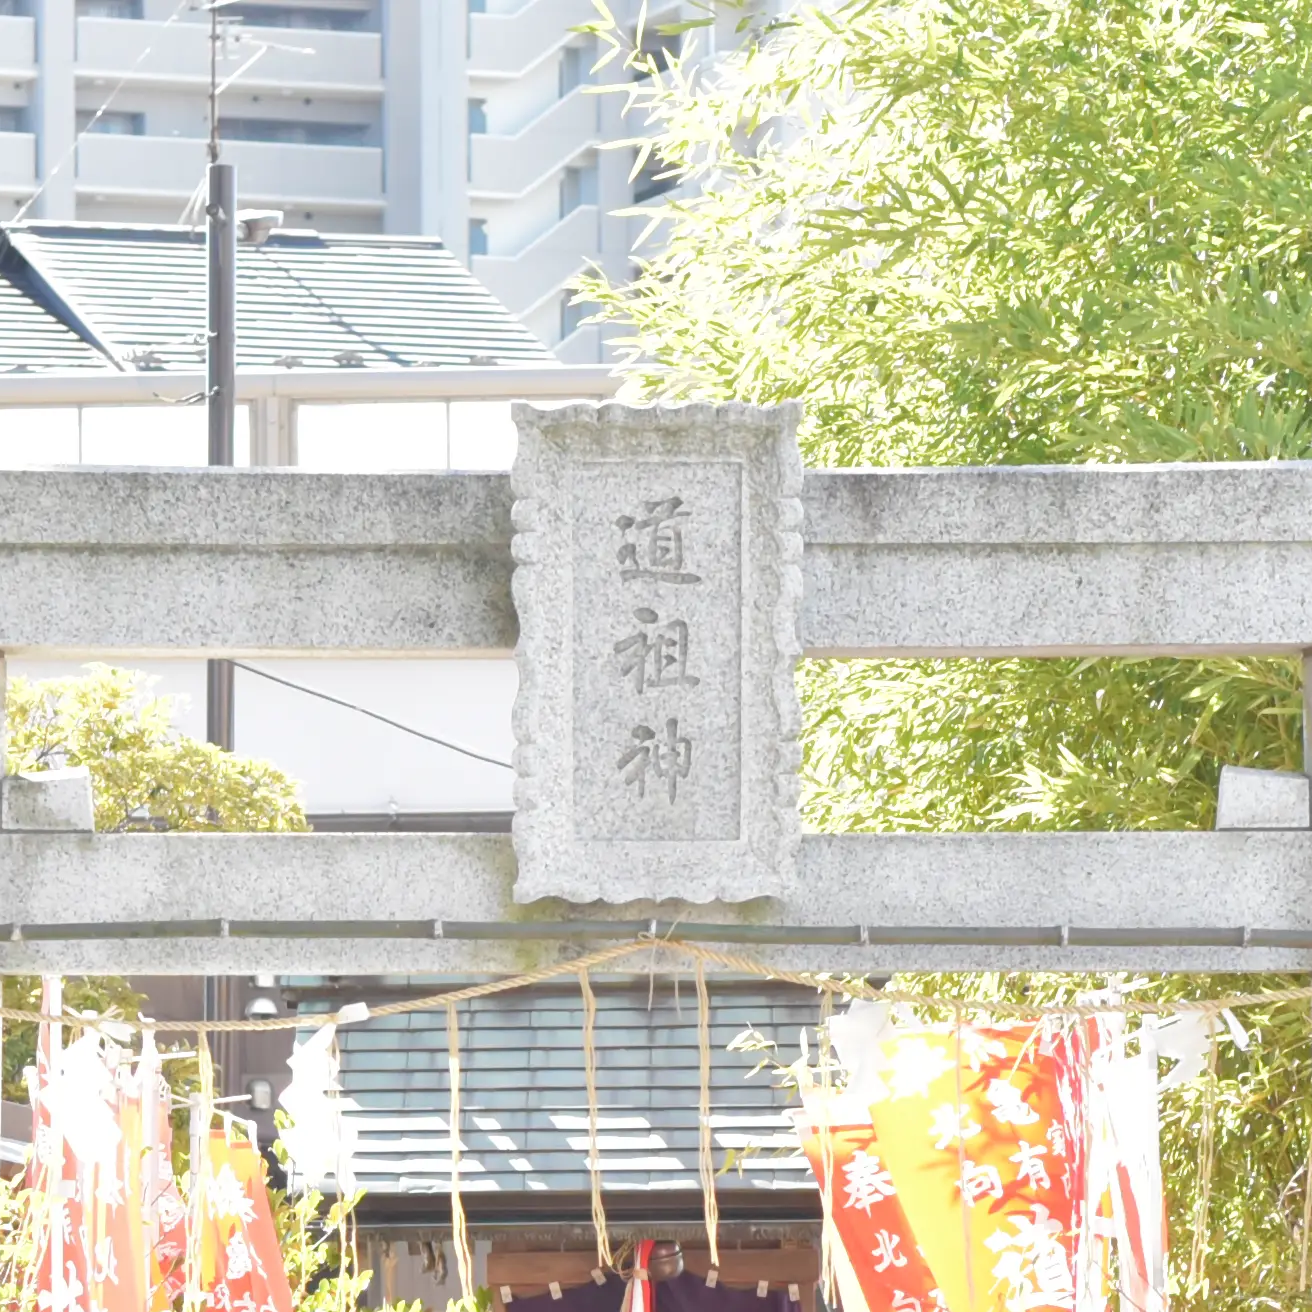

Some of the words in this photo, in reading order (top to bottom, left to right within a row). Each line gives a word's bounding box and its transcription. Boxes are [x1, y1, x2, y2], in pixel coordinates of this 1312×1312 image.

[612, 495, 702, 806] 道祖神
[842, 1150, 896, 1219] 奉
